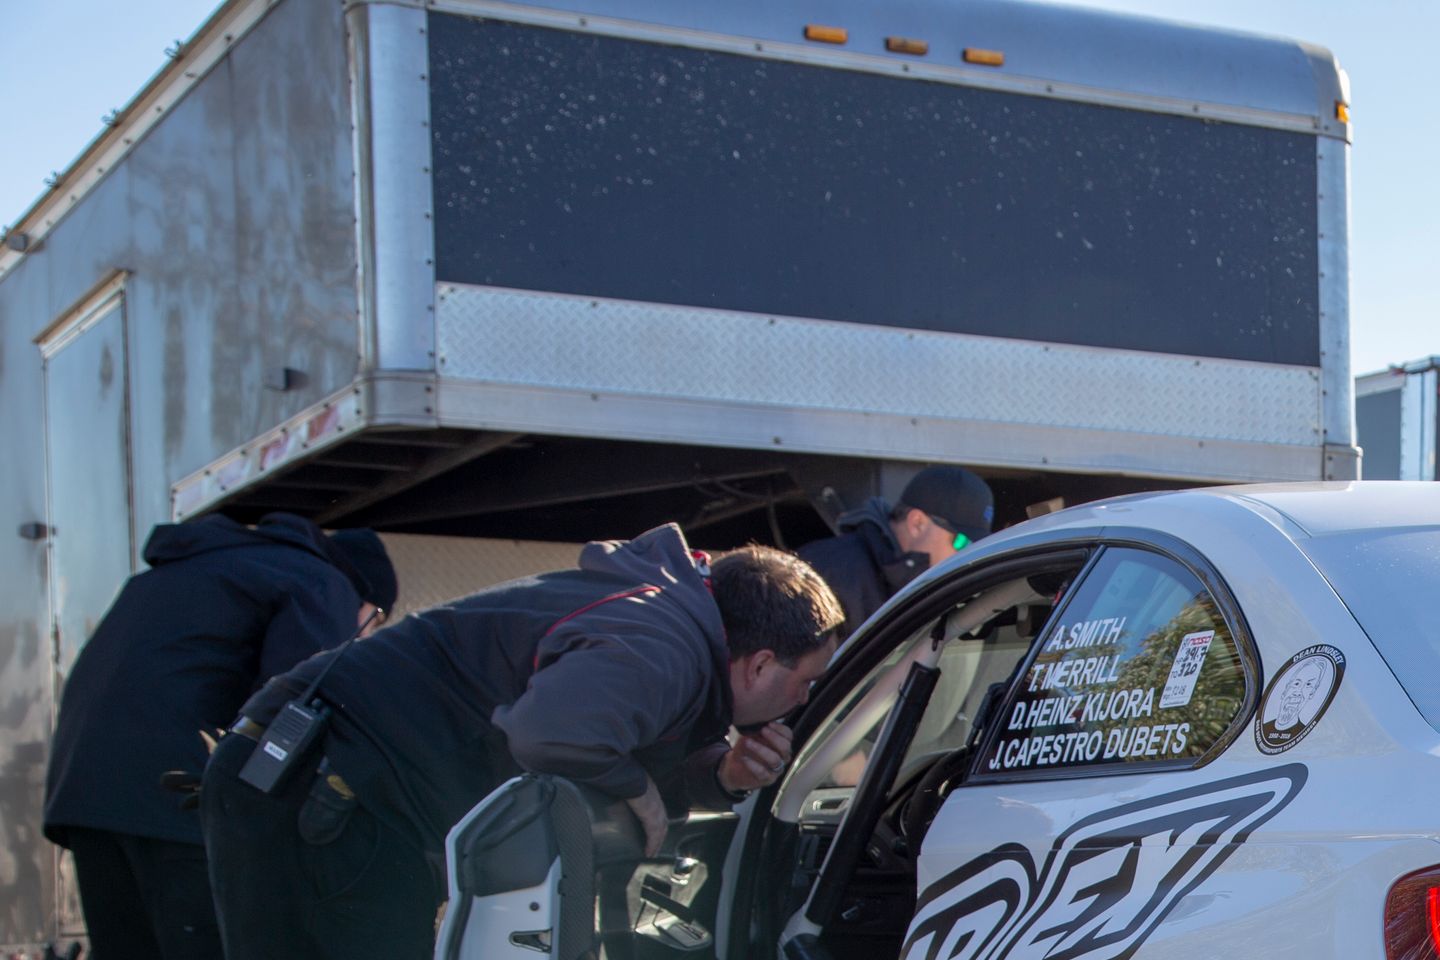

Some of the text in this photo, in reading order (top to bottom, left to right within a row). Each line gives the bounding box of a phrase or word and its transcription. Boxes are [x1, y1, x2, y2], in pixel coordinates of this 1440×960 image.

[1293, 645, 1344, 665] DEAN LINDSLEY
[1178, 662, 1198, 678] 320
[1081, 687, 1155, 722] KIJORA
[1102, 722, 1191, 760] DUBETS
